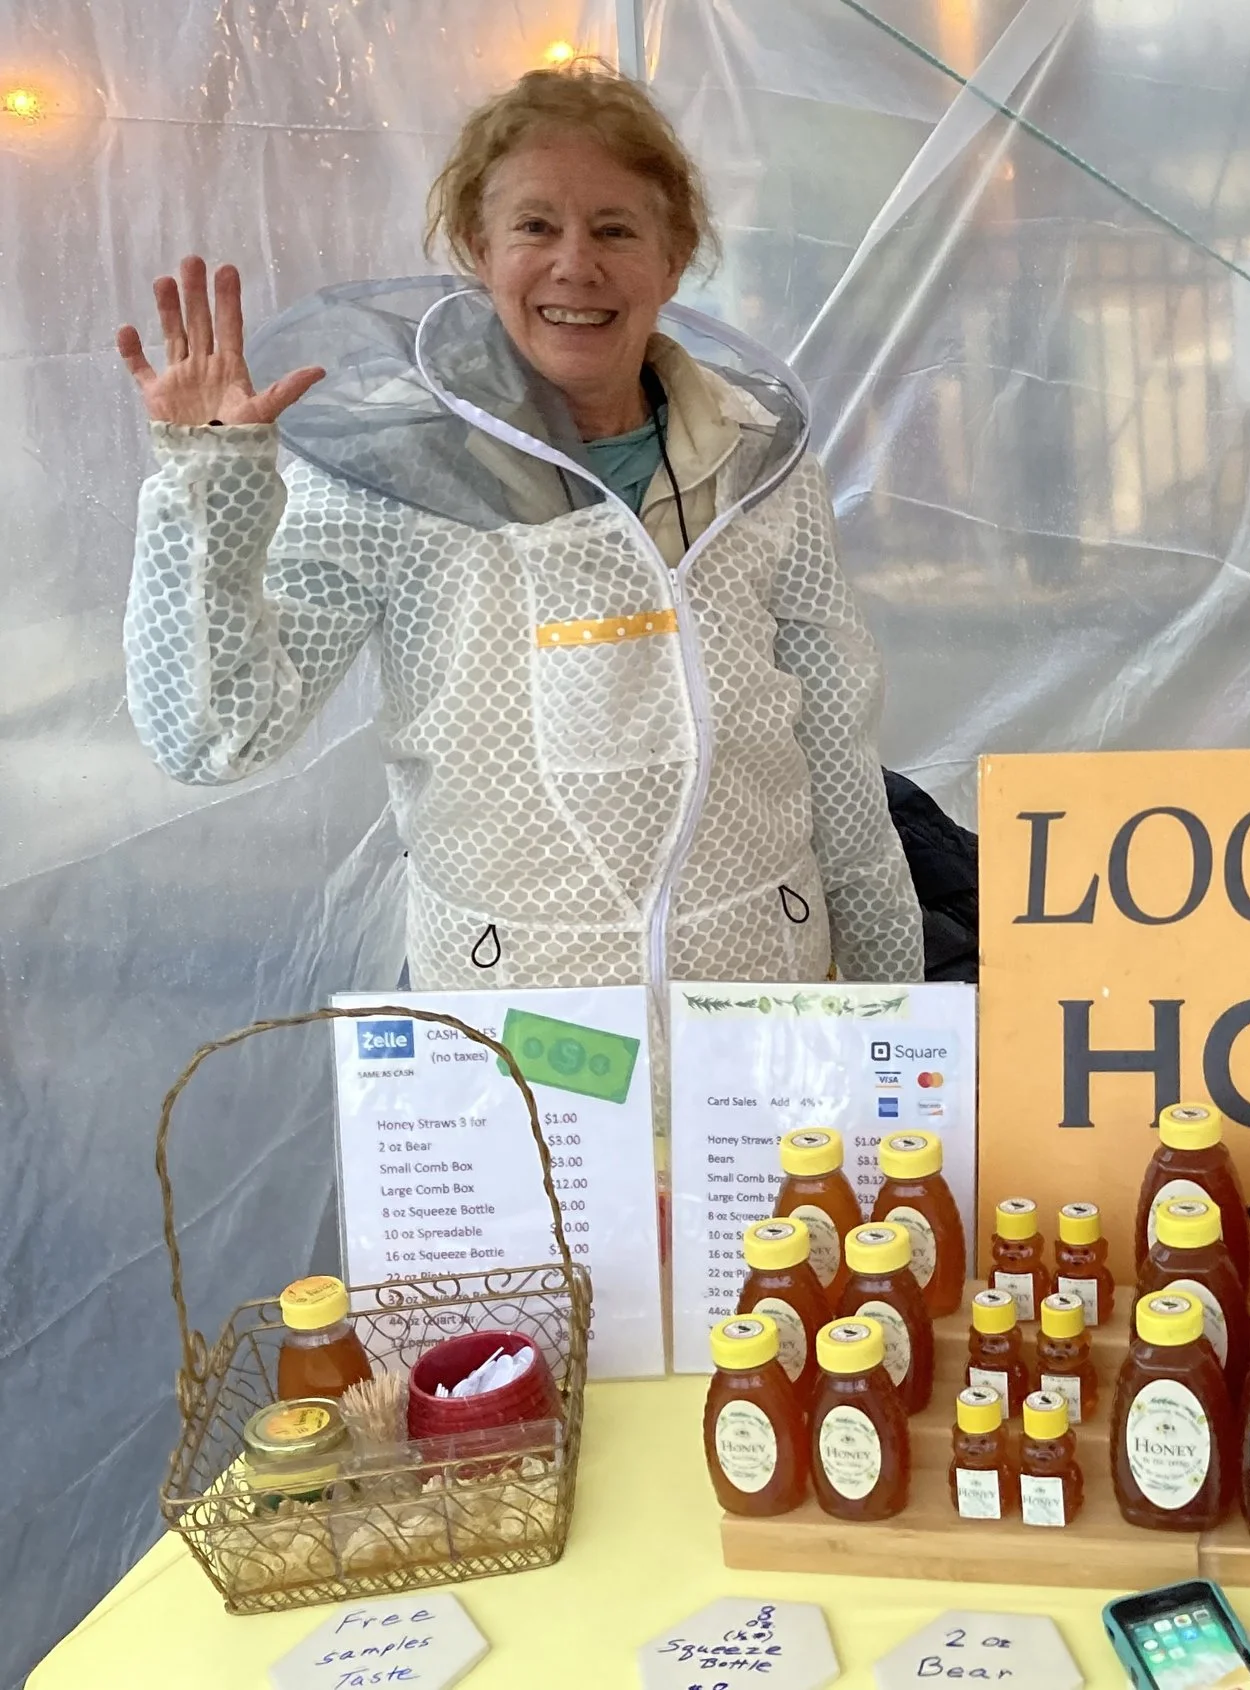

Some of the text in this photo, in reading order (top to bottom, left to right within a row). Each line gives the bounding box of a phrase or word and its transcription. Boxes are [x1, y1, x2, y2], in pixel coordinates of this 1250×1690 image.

[362, 1031, 408, 1050] Zelle
[427, 1029, 458, 1041] CASH
[432, 1049, 489, 1064] (no taxes)
[894, 1045, 947, 1061] Square
[879, 1076, 899, 1084] VISA
[707, 1096, 730, 1106] Card
[732, 1096, 757, 1106] Sales
[770, 1097, 790, 1106] Add
[377, 1116, 487, 1131] Honey Straws 3 for
[544, 1112, 578, 1125] $1.00
[379, 1141, 432, 1153] 2 oz Bear
[548, 1135, 581, 1147] $3.00
[707, 1135, 738, 1147] Honey
[742, 1136, 773, 1145] Straws
[551, 1156, 583, 1168] $3.00
[708, 1154, 735, 1164] Bears
[857, 1155, 879, 1167] $3.1
[380, 1161, 473, 1174] Small Comb Box
[707, 1173, 734, 1183] Small
[736, 1174, 765, 1183] Comb
[381, 1183, 475, 1198] Large Comb Box
[708, 1192, 734, 1203] Large
[736, 1193, 765, 1203] Comb
[382, 1204, 495, 1219] 8 oz Squeeze Bottle
[560, 1200, 586, 1211] 8.00
[716, 1212, 728, 1220] oz
[730, 1211, 770, 1222] Squeeze
[384, 1226, 483, 1240] 10 oz Spreadable
[550, 1222, 590, 1234] $0.00
[709, 1230, 720, 1240] 10
[723, 1231, 733, 1240] oz
[386, 1247, 505, 1262] 16 oz Squeeze Bottle
[709, 1250, 720, 1259] 16
[723, 1250, 733, 1259] oz
[708, 1268, 720, 1278] 22
[723, 1269, 733, 1278] oz
[708, 1287, 720, 1297] 32
[723, 1288, 733, 1297] oz
[708, 1306, 731, 1316] 44oz
[720, 1439, 767, 1453] HONEY
[826, 1445, 871, 1460] HONEY
[1135, 1436, 1197, 1458] HONEY
[757, 1605, 776, 1621] 8
[335, 1607, 436, 1634] Free
[946, 1629, 1012, 1648] 2 oz
[315, 1636, 433, 1665] samples
[658, 1639, 782, 1661] Squeeze
[700, 1657, 772, 1673] Bottle
[917, 1655, 1013, 1680] Bear
[334, 1664, 420, 1690] Taste
